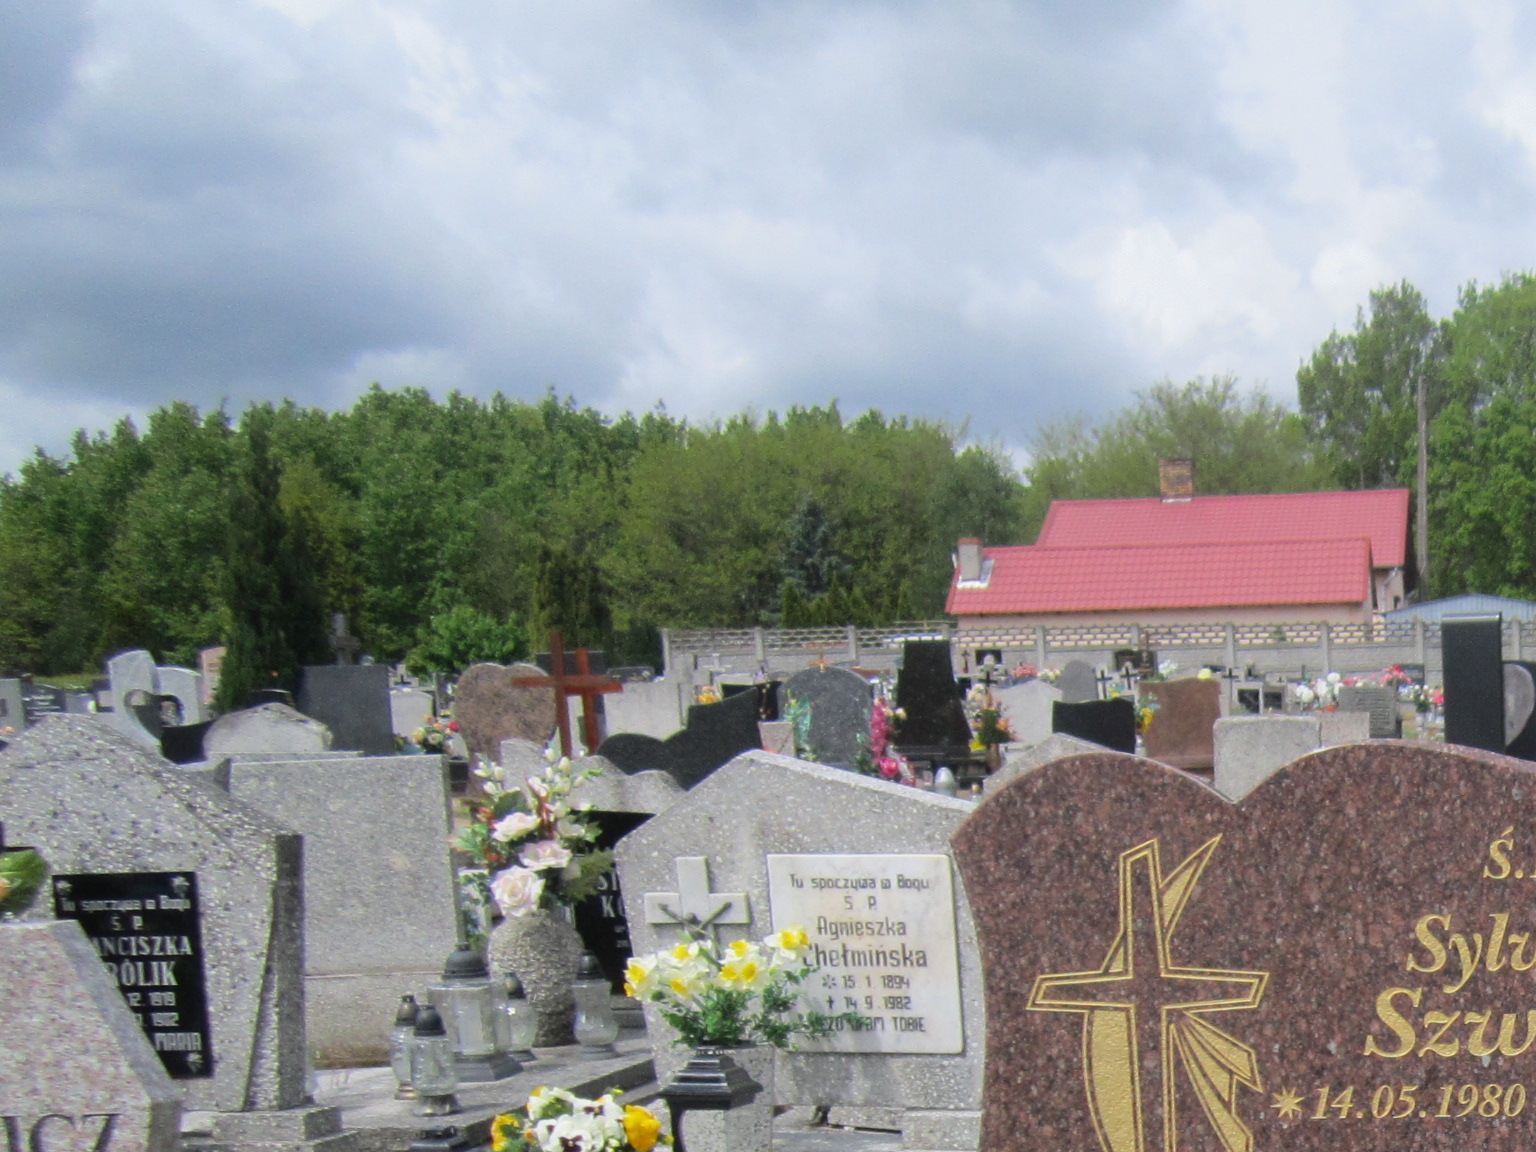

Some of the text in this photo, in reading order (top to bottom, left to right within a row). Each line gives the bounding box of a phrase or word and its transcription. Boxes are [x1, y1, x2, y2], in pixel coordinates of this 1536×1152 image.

[789, 873, 804, 889] Tu
[811, 878, 877, 891] spoczywa
[896, 873, 931, 891] Bogu
[816, 915, 907, 941] Agnieszka
[881, 974, 910, 989] 1894
[883, 996, 912, 1010] 1982
[892, 1016, 926, 1032] TOBIE
